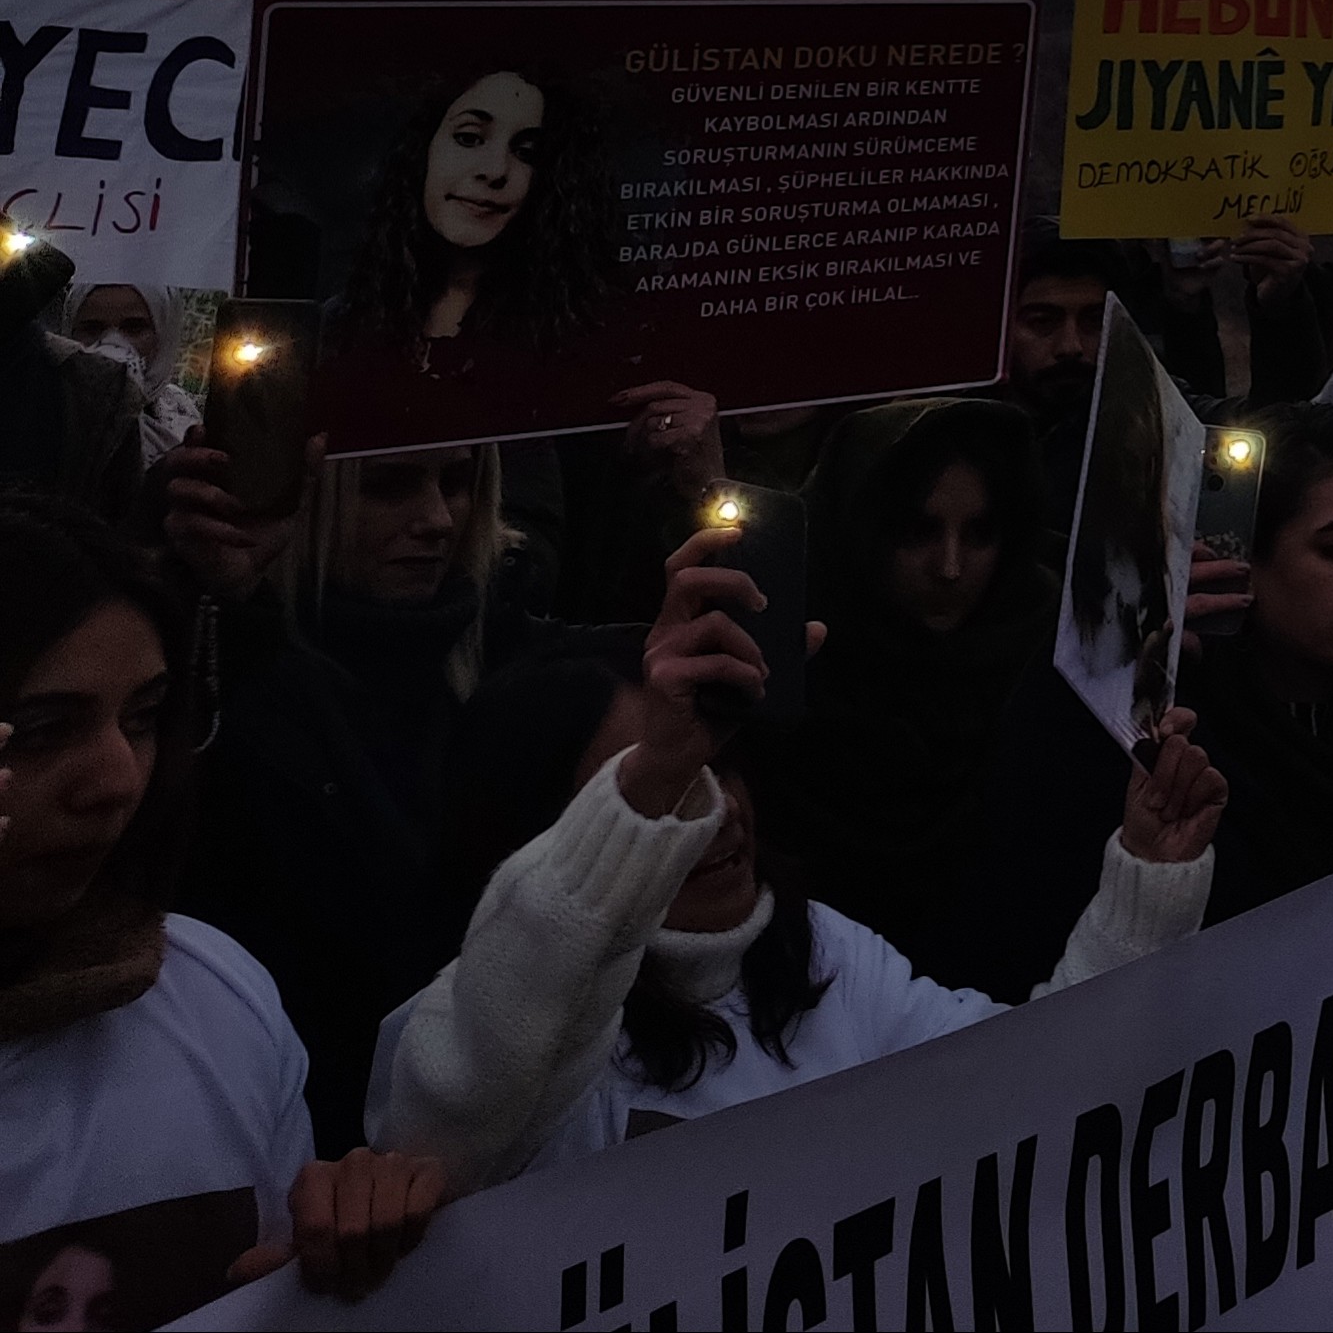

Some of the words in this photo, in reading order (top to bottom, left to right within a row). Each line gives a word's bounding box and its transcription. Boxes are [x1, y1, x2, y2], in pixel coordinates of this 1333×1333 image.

[624, 42, 784, 73] GÜLİSTAN
[794, 44, 878, 69] DOKU
[0, 21, 247, 161] YEC
[671, 81, 765, 103] GÜVENLİ
[770, 79, 860, 100] DENİLEN
[866, 78, 900, 97] BİR
[905, 78, 981, 95] KENTTE
[1075, 47, 1285, 131] JIYANÊ
[704, 113, 838, 133] KAYBOLMASI
[843, 108, 948, 127] ARDINDAN
[663, 142, 847, 167] SORUŞTURMANIN
[852, 136, 978, 156] SÜRÜMCEME
[778, 167, 904, 193] ŞÜPHELİLER
[910, 164, 1009, 183] HAKKINDA
[626, 207, 692, 230] ETKİN
[699, 205, 735, 226] BİR
[739, 199, 881, 223] SORUŞTURMA
[618, 240, 720, 262] BARAJDA
[726, 231, 839, 255] GÜNLERCE
[842, 226, 918, 246] ARANIP
[922, 221, 1000, 240] KARADA
[635, 268, 751, 293] ARAMANIN
[758, 260, 820, 283] EKSİK
[825, 252, 953, 277] BIRAKILMASI
[958, 250, 982, 266] VE
[700, 298, 758, 317] DAHA
[765, 292, 799, 312] BİR
[805, 289, 846, 311] ÇOK
